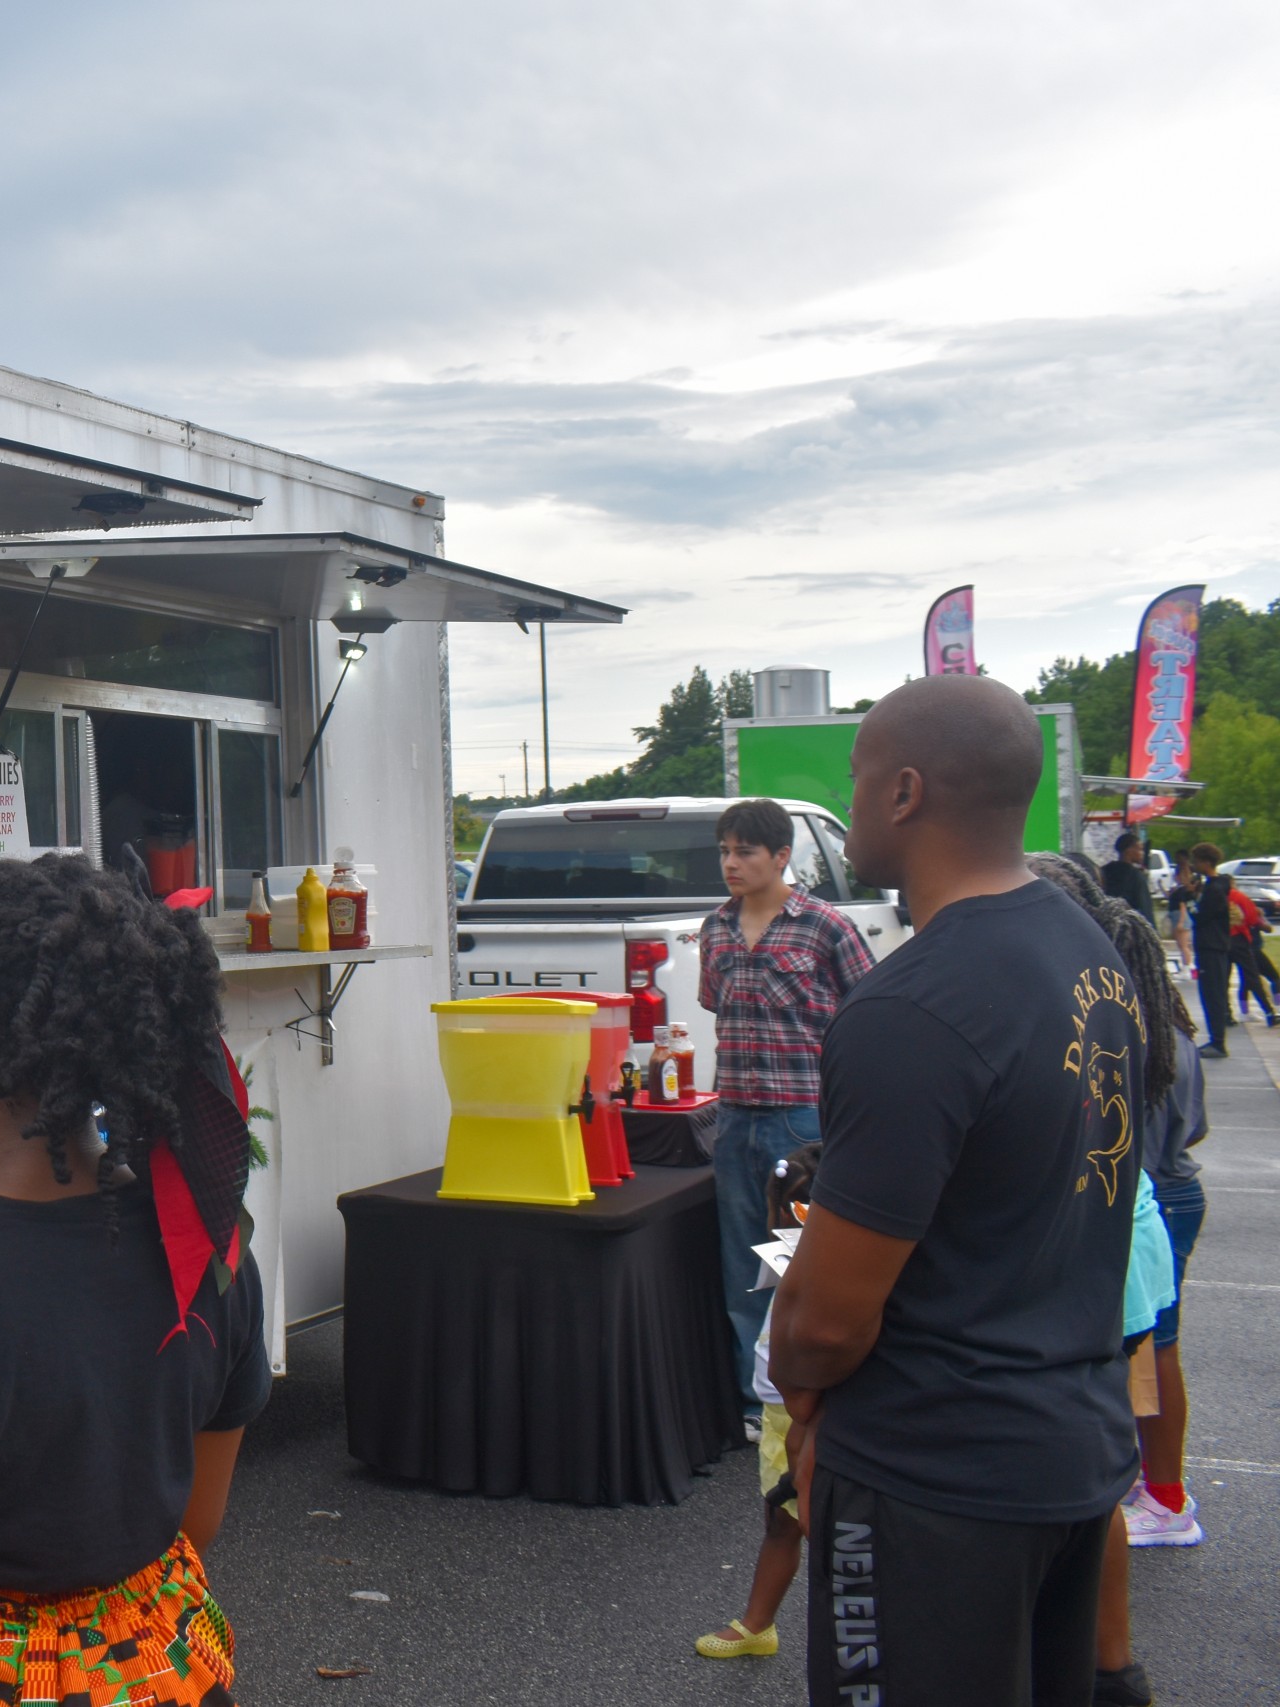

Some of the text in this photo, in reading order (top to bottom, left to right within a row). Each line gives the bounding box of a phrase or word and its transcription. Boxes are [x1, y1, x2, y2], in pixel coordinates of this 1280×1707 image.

[676, 933, 701, 945] 4X
[457, 971, 598, 987] OLET
[1064, 968, 1100, 1080] DARK
[832, 1521, 879, 1669] NELEUS
